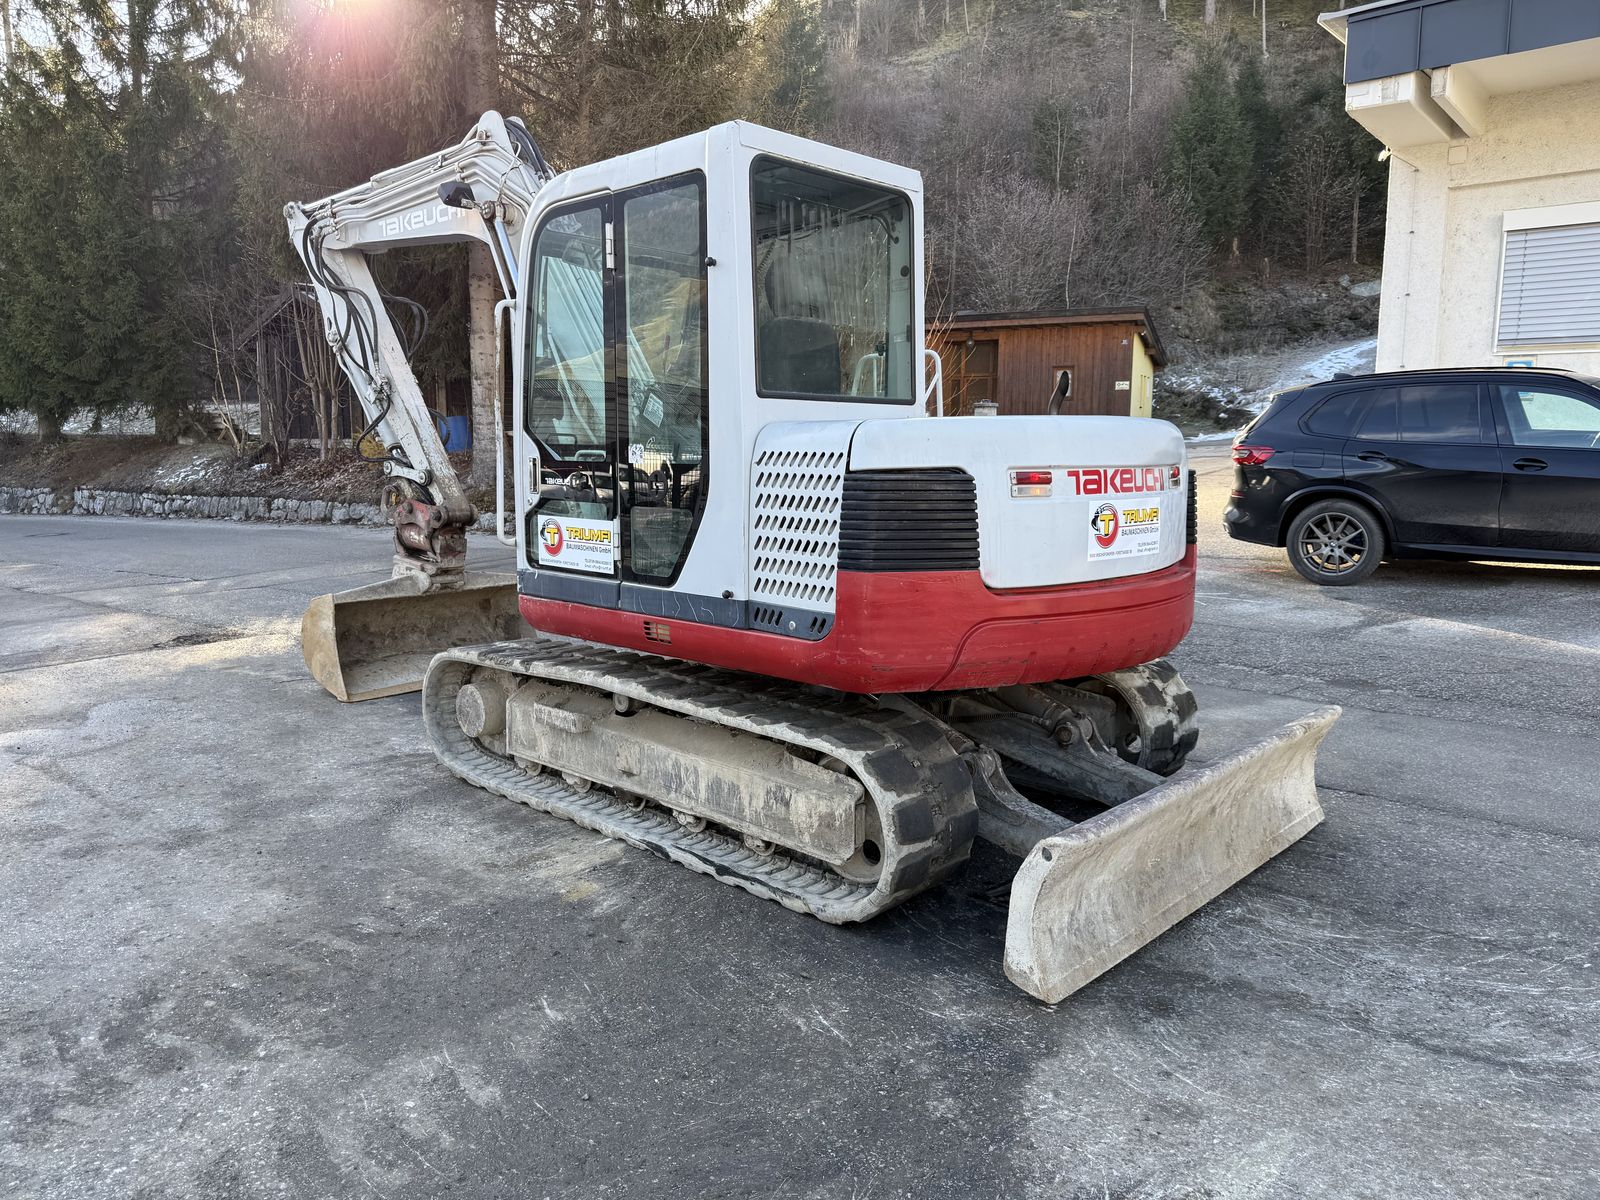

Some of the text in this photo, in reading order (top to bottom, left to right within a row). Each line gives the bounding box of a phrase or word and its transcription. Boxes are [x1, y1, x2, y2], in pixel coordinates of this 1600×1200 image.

[1067, 468, 1164, 495] TAKEUCHI
[1100, 514, 1115, 536] T
[546, 528, 559, 546] T
[566, 543, 611, 554] BAUMASCHINEN GmbH
